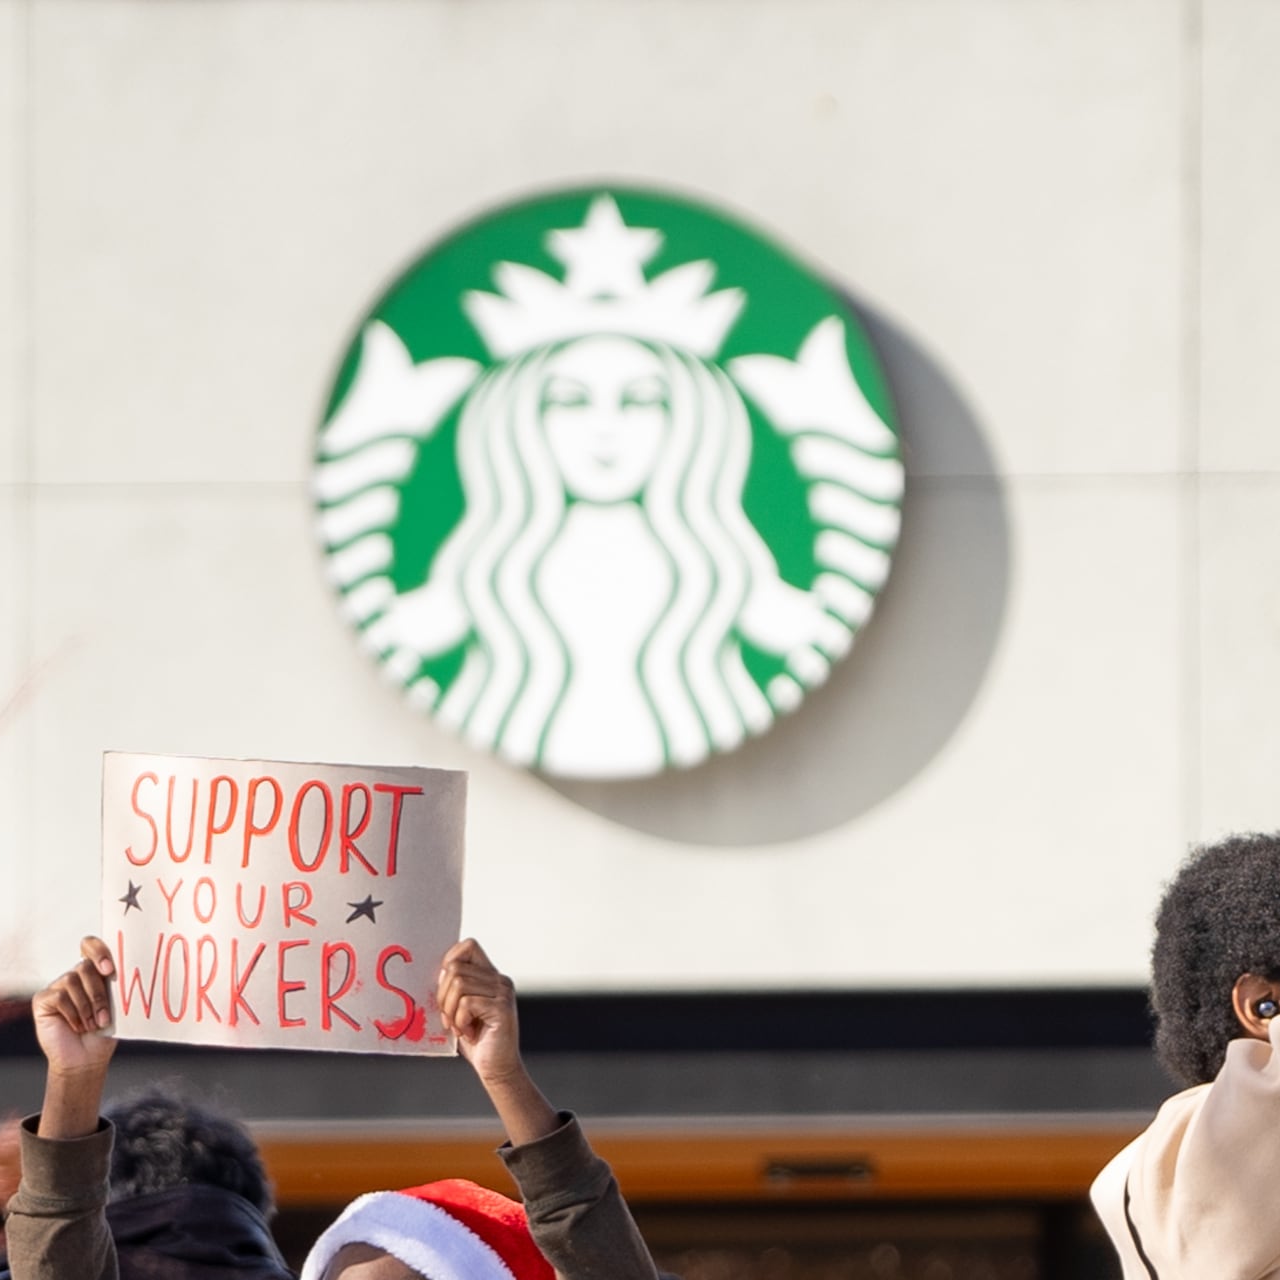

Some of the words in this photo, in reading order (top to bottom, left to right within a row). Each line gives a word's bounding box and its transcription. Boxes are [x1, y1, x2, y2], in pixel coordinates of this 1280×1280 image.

[125, 771, 424, 877] SUPPORT
[157, 877, 317, 928] YOUR
[118, 930, 422, 1040] WORKERS
